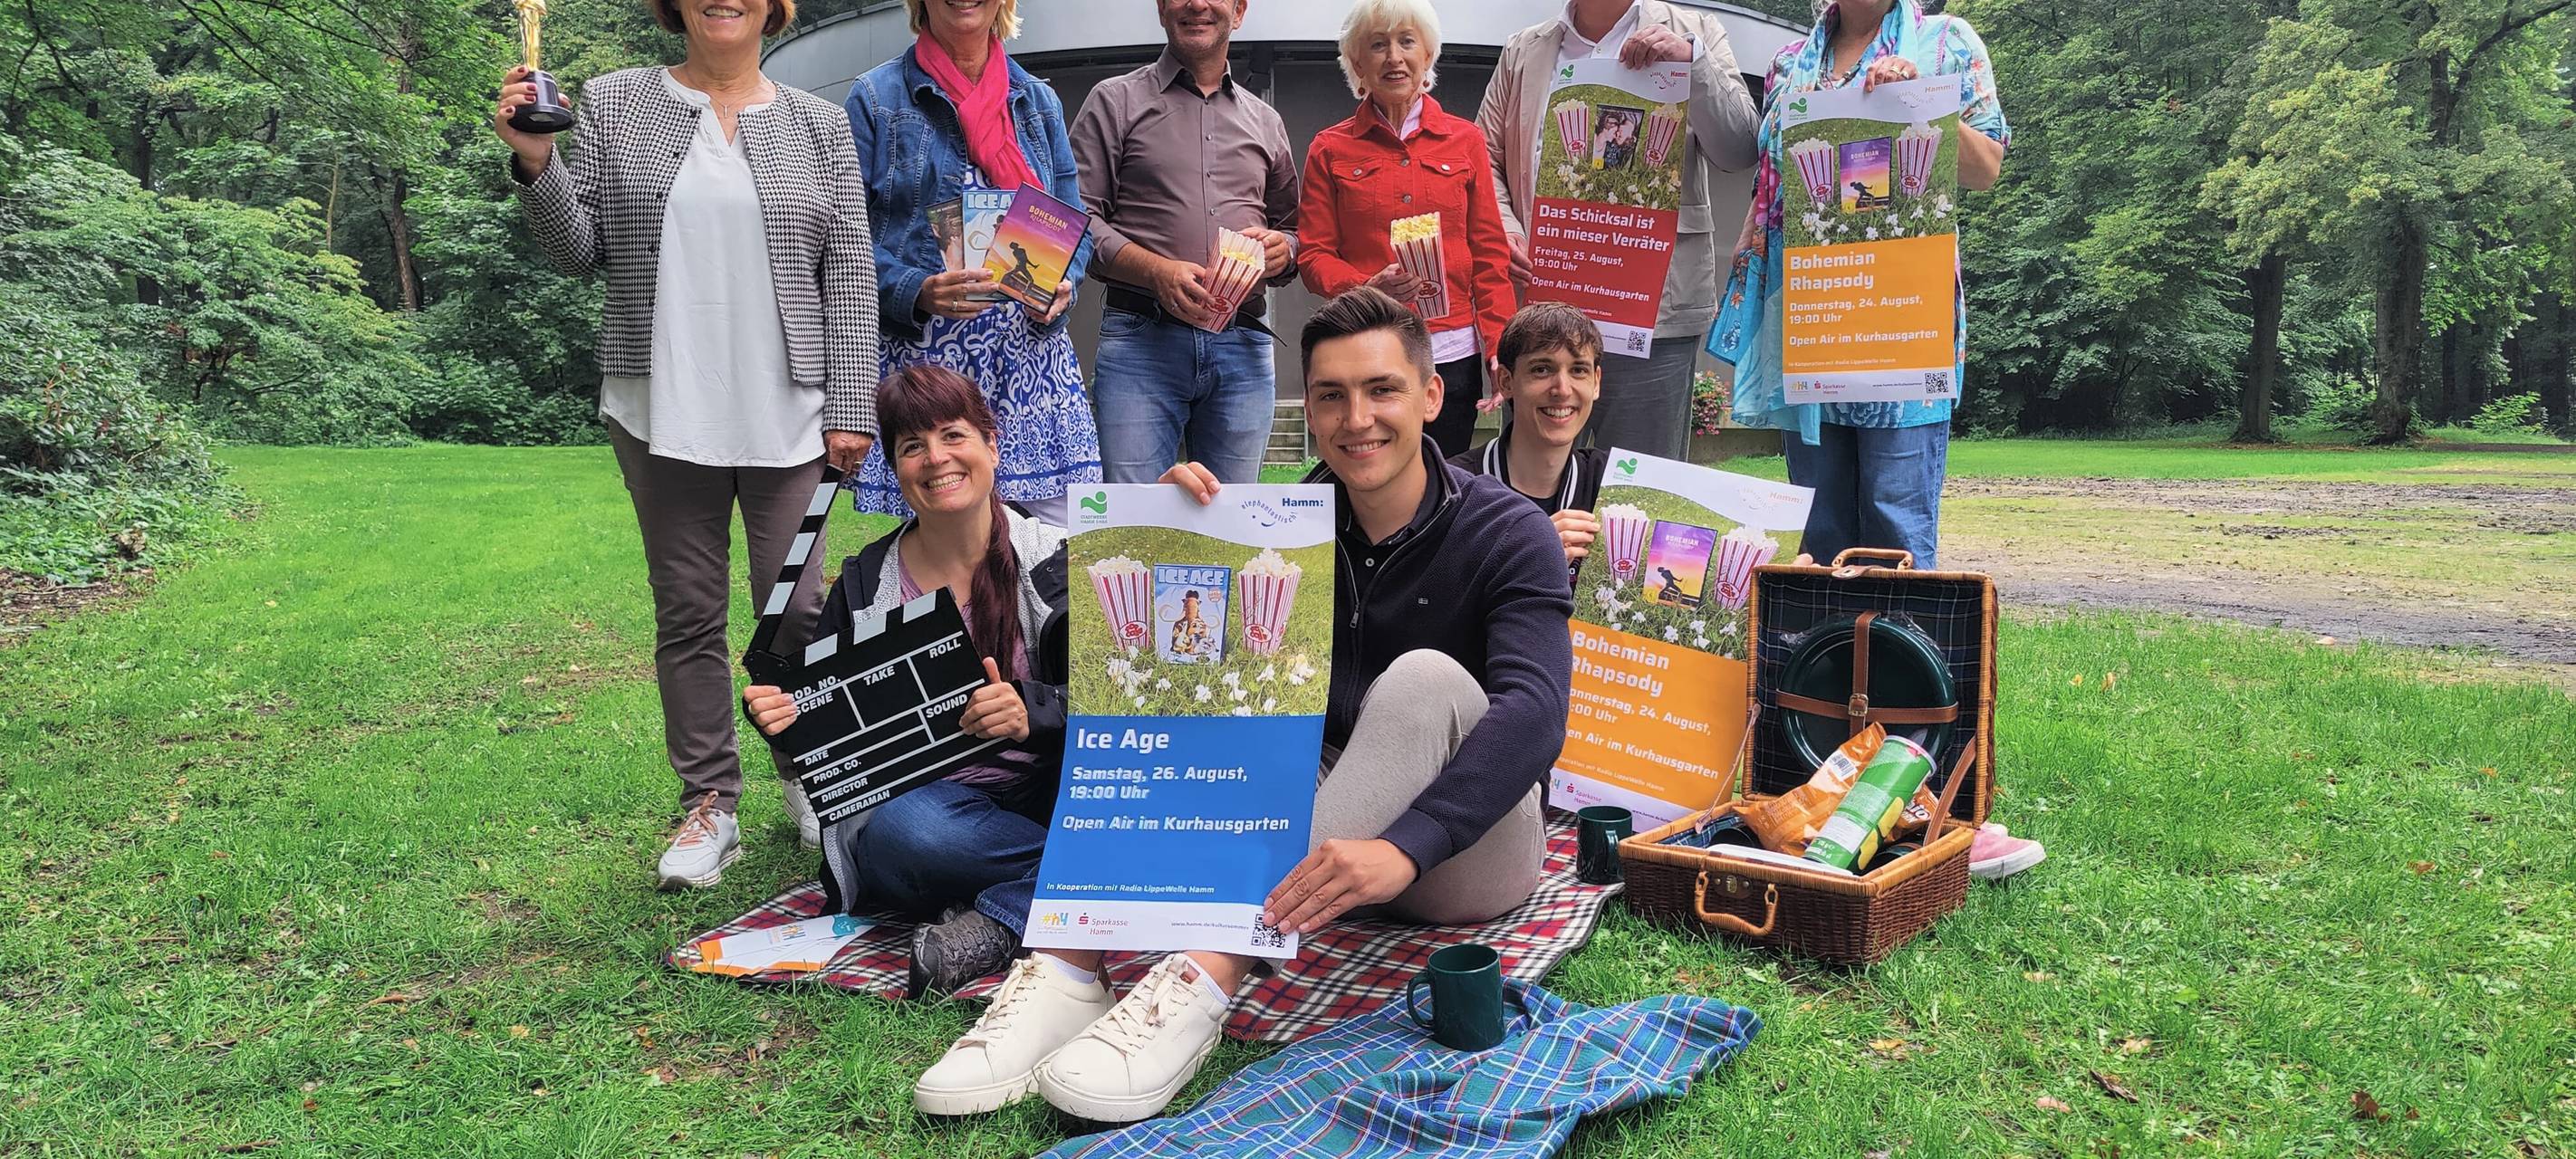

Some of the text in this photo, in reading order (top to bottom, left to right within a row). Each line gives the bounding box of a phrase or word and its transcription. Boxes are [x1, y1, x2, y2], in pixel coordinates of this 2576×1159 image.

[967, 193, 997, 209] ICE
[1028, 205, 1069, 229] BOHEMIAN
[1539, 205, 1655, 230] Das Schicksal ist
[1537, 223, 1670, 252] ein mieser Verräter
[1533, 258, 1578, 271] 19:00 Uhr
[1535, 246, 1624, 267] Freitag, 25. August,
[1790, 251, 1876, 270] Bohemian
[1532, 276, 1649, 302] Open Air im Kurhausgarten
[1790, 272, 1874, 292] Rhapsody
[1790, 294, 1923, 312] Donnerstag, 24. August,
[1789, 313, 1843, 324] 19:00 Uhr
[1789, 329, 1938, 347] Open Air im Kurhausgarten
[1282, 497, 1323, 507] Hamm:
[1158, 568, 1225, 586] ICE AGE
[928, 638, 962, 659] ROLL
[1572, 630, 1669, 670] Bohemian
[817, 675, 841, 690] NO.
[863, 666, 896, 686] TAKE
[926, 693, 968, 719] SOUND
[1570, 687, 1711, 736] onnerstag, 24. August,
[1570, 703, 1619, 723] :00 Uhr
[1076, 728, 1169, 754] Ice Age
[804, 750, 829, 766] DATE
[1567, 728, 1719, 780] en Air im Kurhausgarten
[812, 759, 862, 784] PROD. CO.
[1072, 766, 1248, 783] Samstag, 26. August,
[821, 777, 869, 803] DIRECTOR
[1069, 785, 1150, 799] 19:00 Uhr
[829, 789, 890, 821] CAMERAMAN
[1062, 815, 1290, 834] Open Air im Kurhausgarten
[1056, 883, 1103, 892] Kooperation
[1104, 883, 1118, 891] mit
[1120, 884, 1143, 892] Radio
[1144, 884, 1187, 894] LippeWelle
[1188, 886, 1215, 894] Hamm
[1091, 918, 1129, 926] Sparkasse
